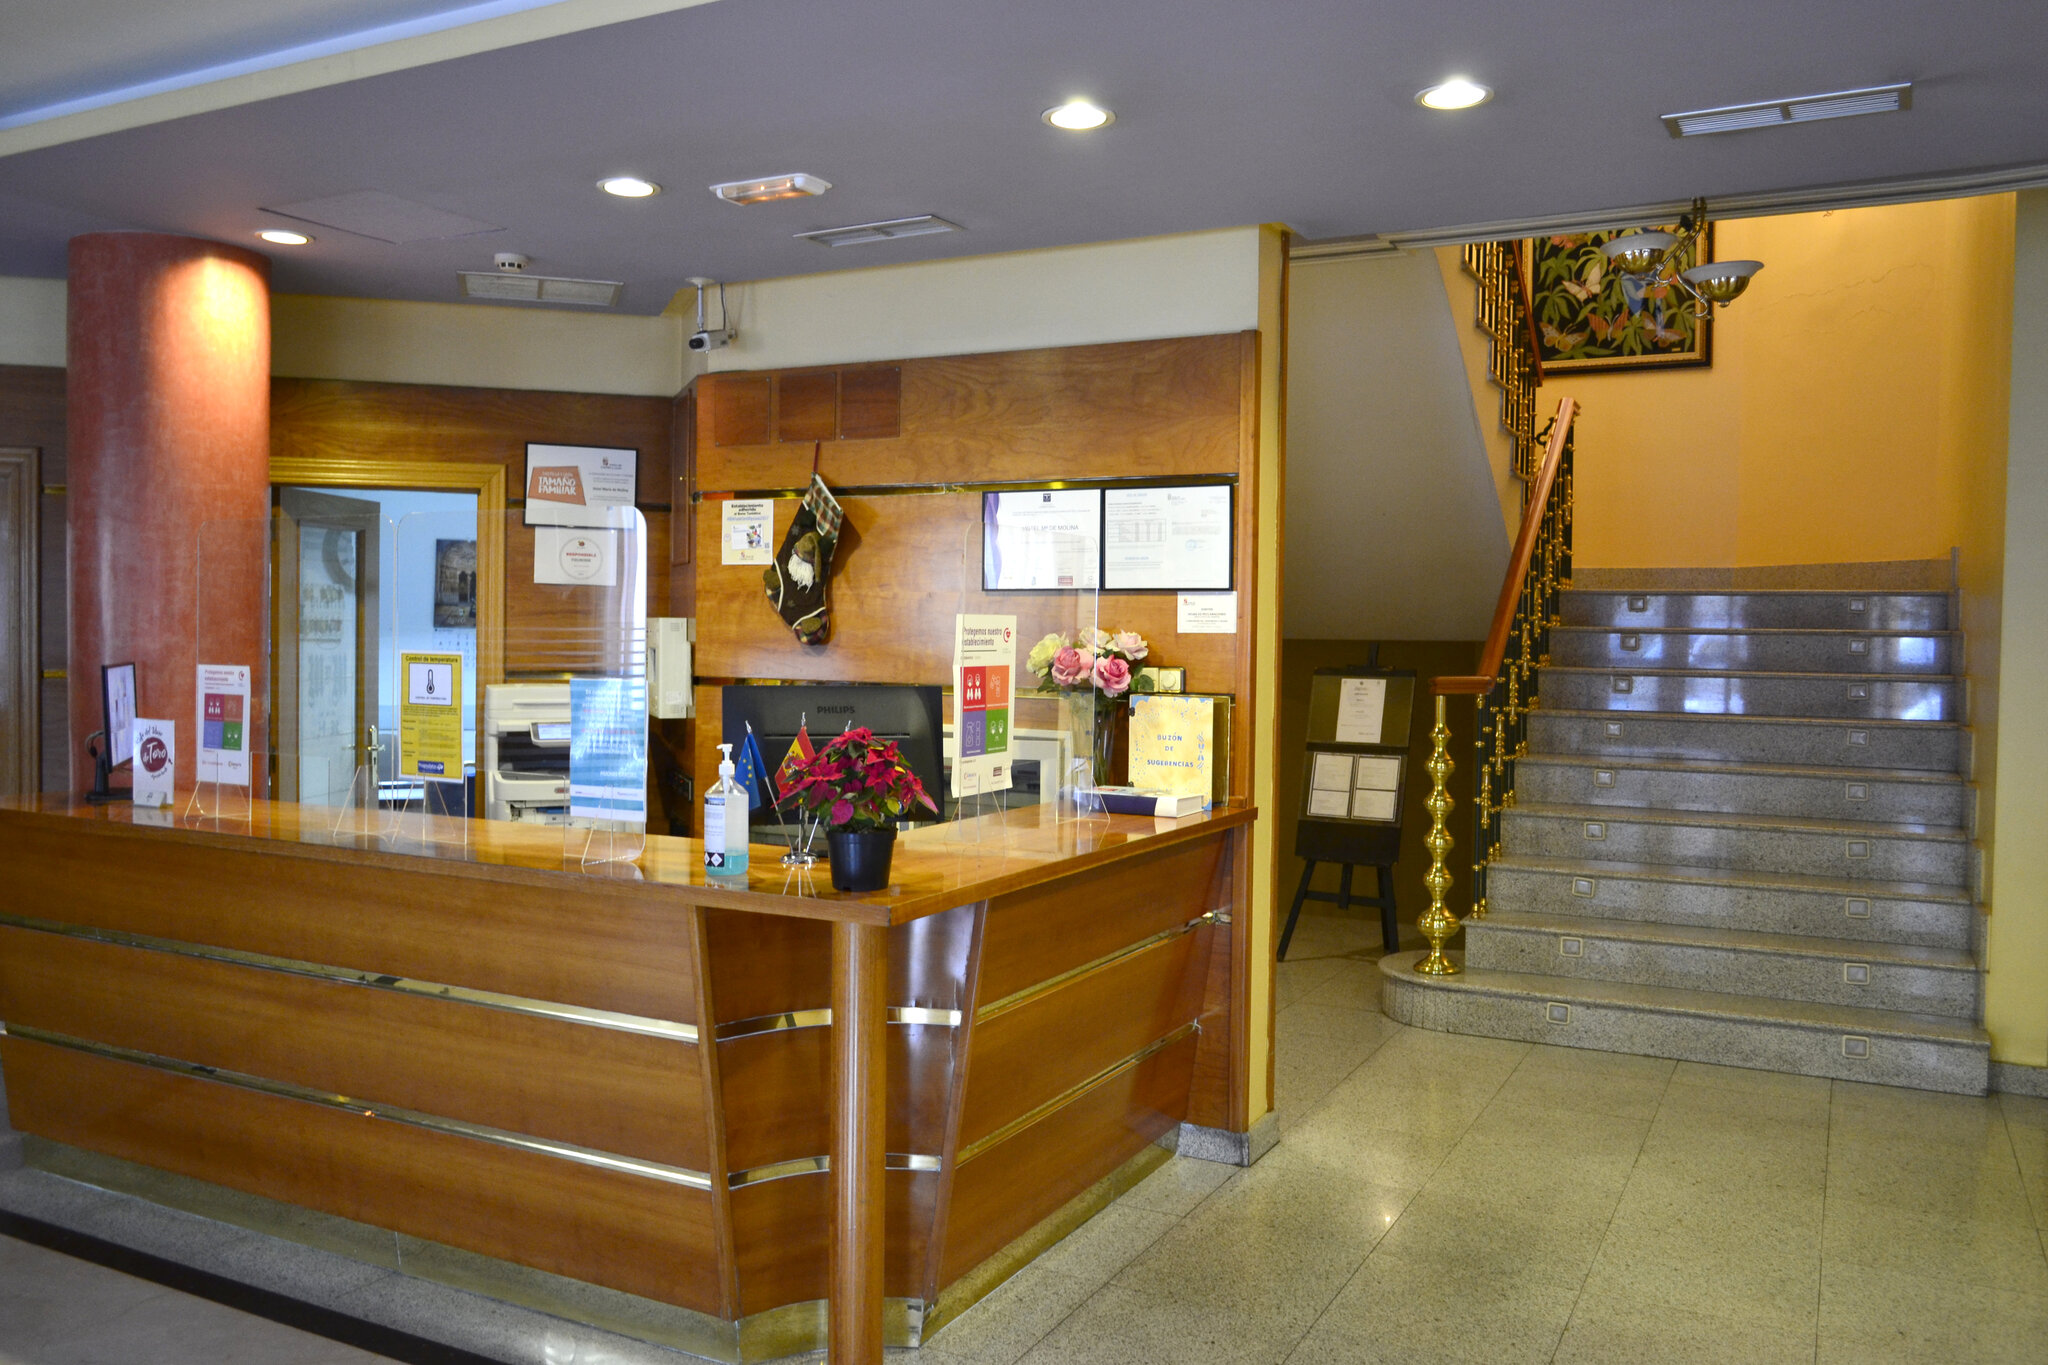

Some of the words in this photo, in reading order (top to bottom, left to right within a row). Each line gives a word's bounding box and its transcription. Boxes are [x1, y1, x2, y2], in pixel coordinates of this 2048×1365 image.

[538, 476, 576, 487] TAMAÑO
[538, 485, 577, 496] FAMILIAR
[816, 705, 856, 714] PHILIPS
[1157, 731, 1183, 741] BUZÓN
[147, 742, 167, 764] Toro
